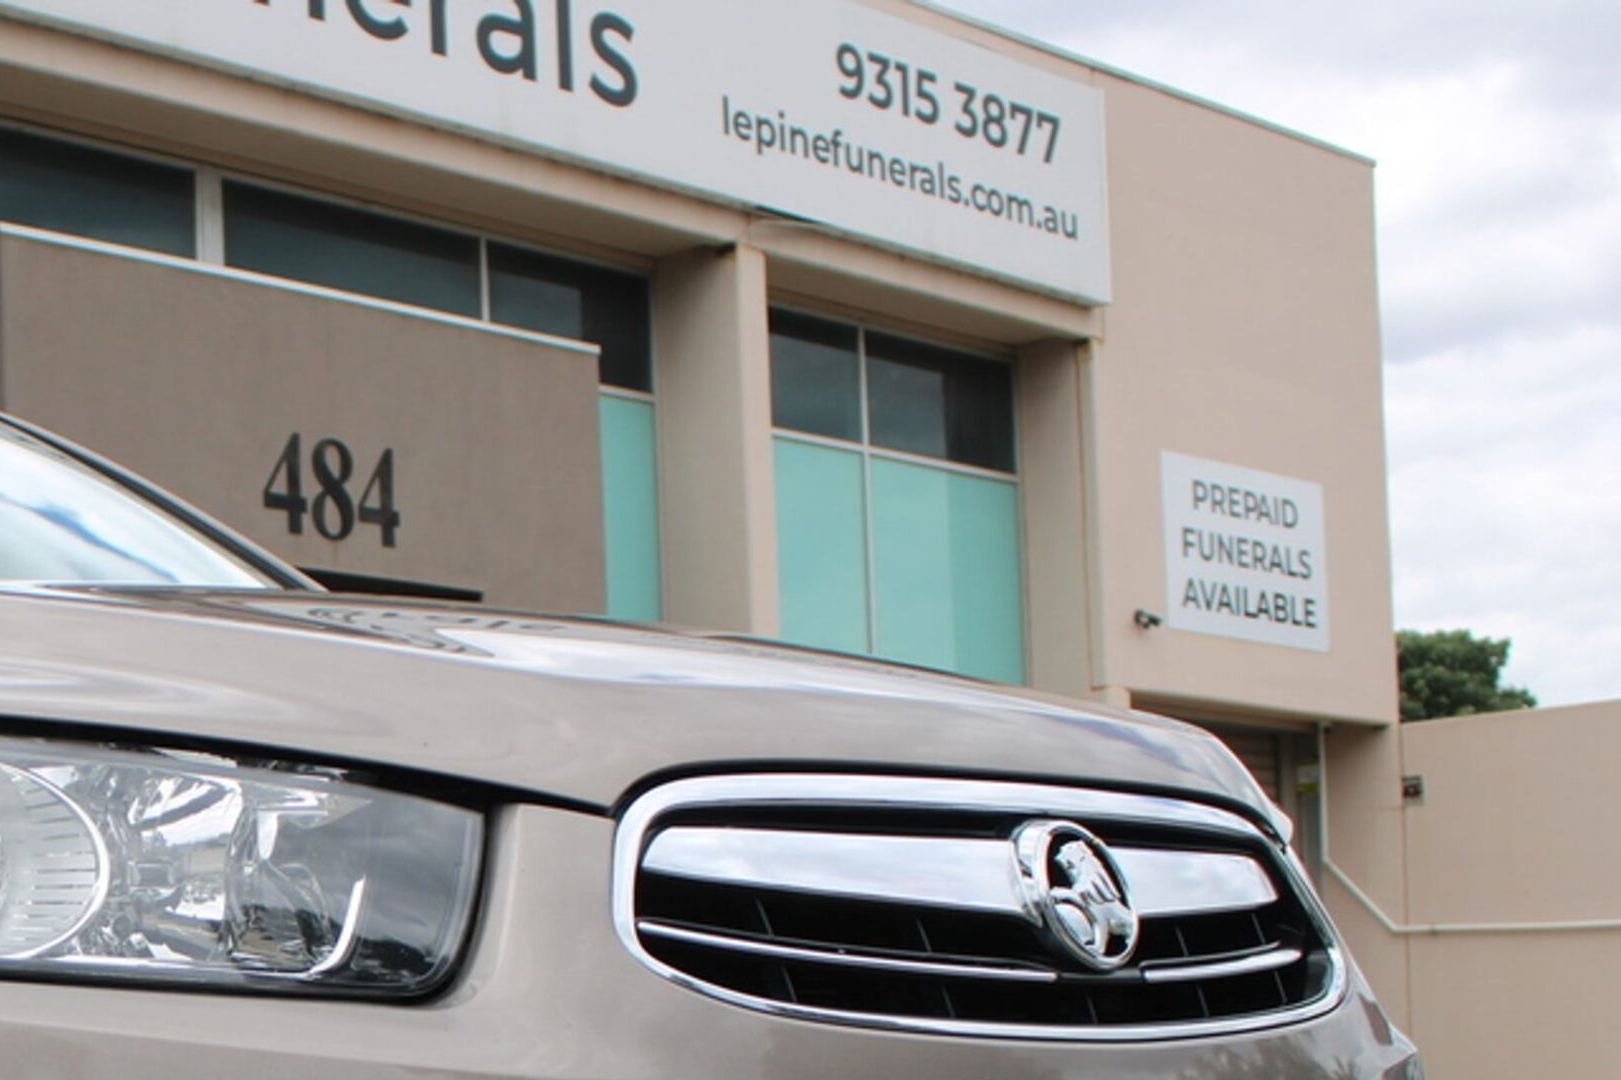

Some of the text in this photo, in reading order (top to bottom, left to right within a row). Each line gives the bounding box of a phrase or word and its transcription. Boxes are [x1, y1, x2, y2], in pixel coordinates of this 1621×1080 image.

[836, 43, 1061, 164] 9315 3877
[721, 94, 1079, 240] lepinefunerals.com.au
[263, 432, 400, 548] 484
[1192, 479, 1299, 529] PREPAID
[1181, 527, 1312, 579] FUNERALS
[1182, 577, 1318, 629] AVAILABLE
